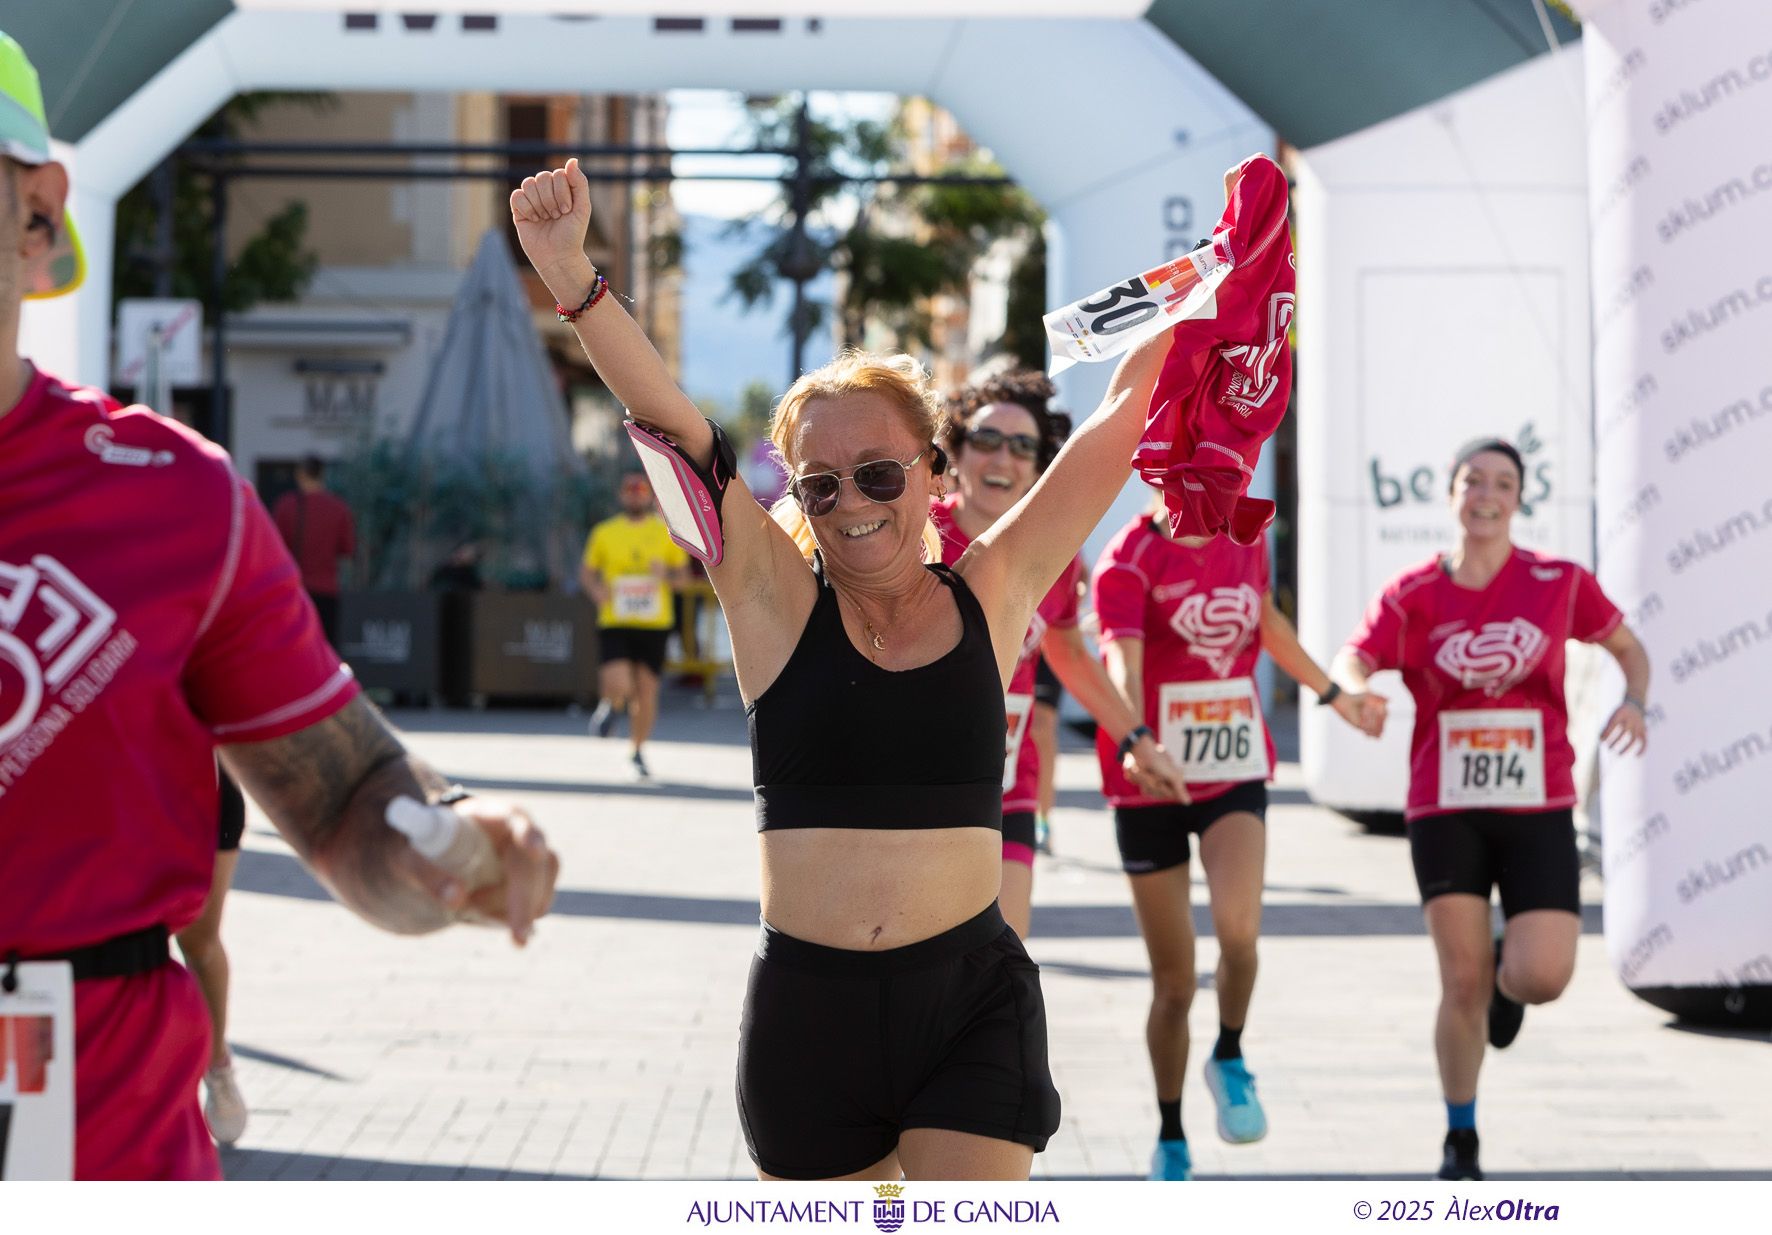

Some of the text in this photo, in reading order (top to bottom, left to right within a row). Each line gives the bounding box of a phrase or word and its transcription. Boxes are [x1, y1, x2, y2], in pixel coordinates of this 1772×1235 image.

[1653, 50, 1772, 136] sklum.c
[1670, 612, 1772, 683] sklum.
[1182, 725, 1250, 763] 1706
[1462, 753, 1525, 788] 1814
